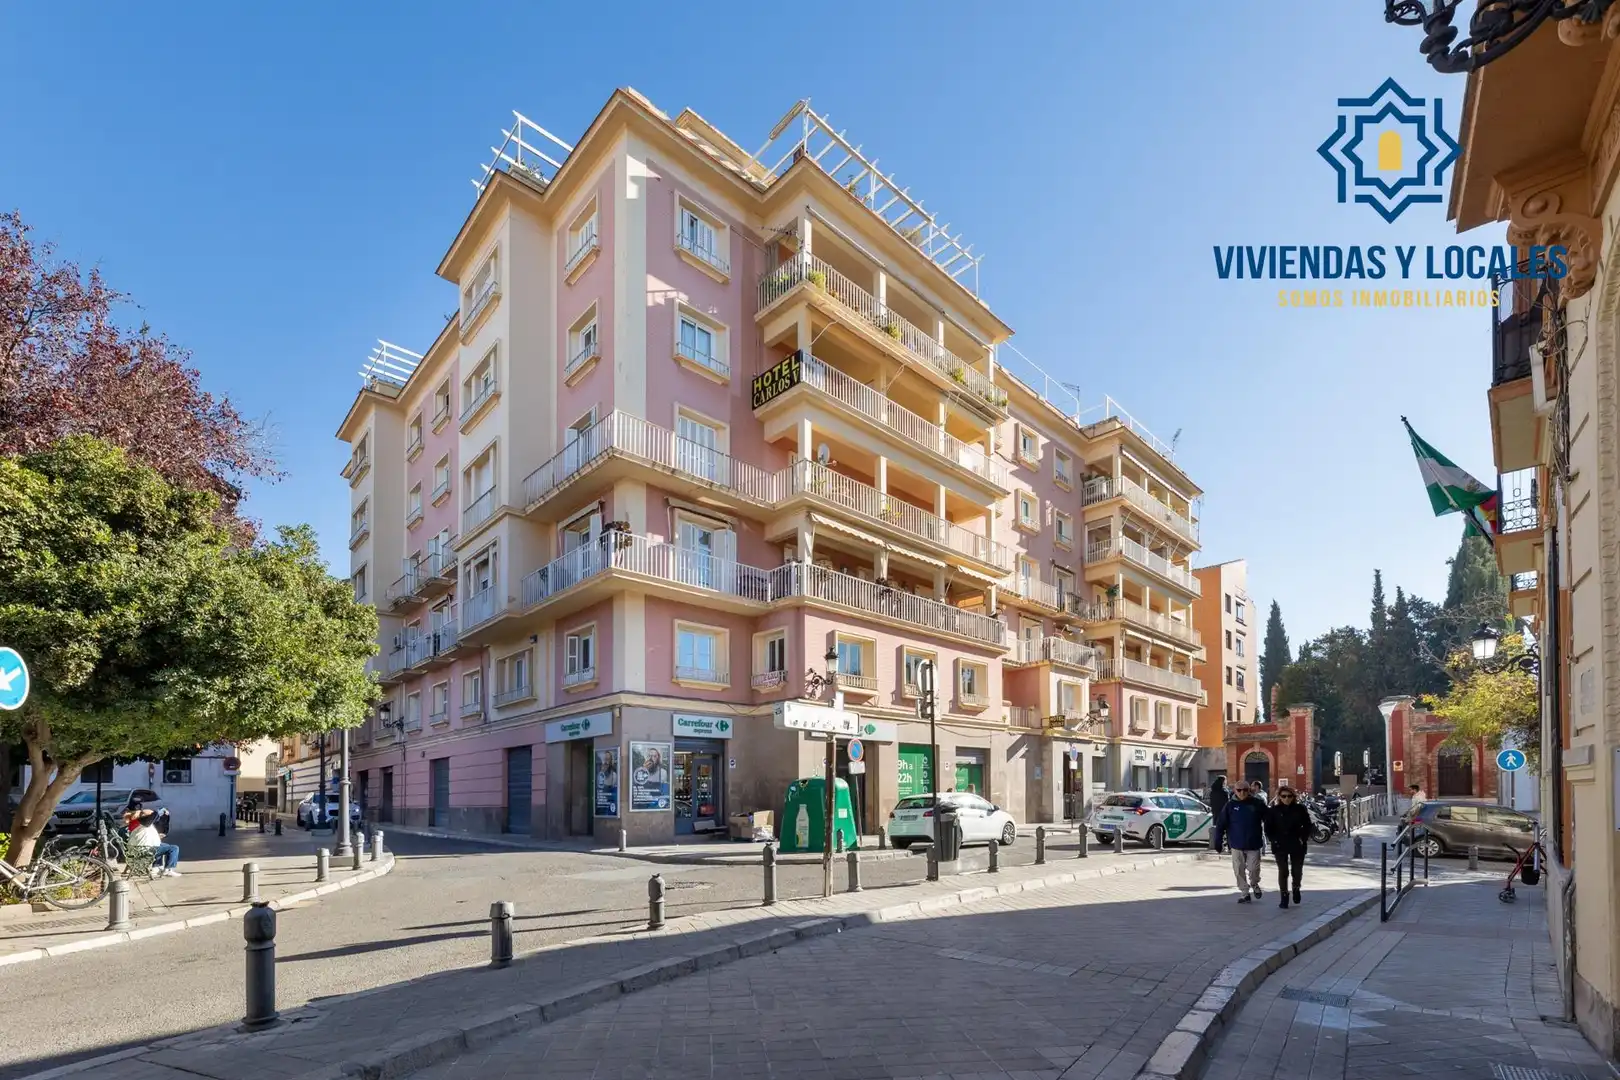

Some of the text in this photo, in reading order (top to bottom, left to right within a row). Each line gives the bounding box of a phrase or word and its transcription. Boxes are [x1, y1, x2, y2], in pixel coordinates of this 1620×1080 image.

[753, 355, 800, 394] HOTEL
[753, 374, 791, 408] CARLOS
[677, 718, 713, 728] Carrefour
[897, 760, 908, 770] 9h
[897, 773, 912, 783] 22h
